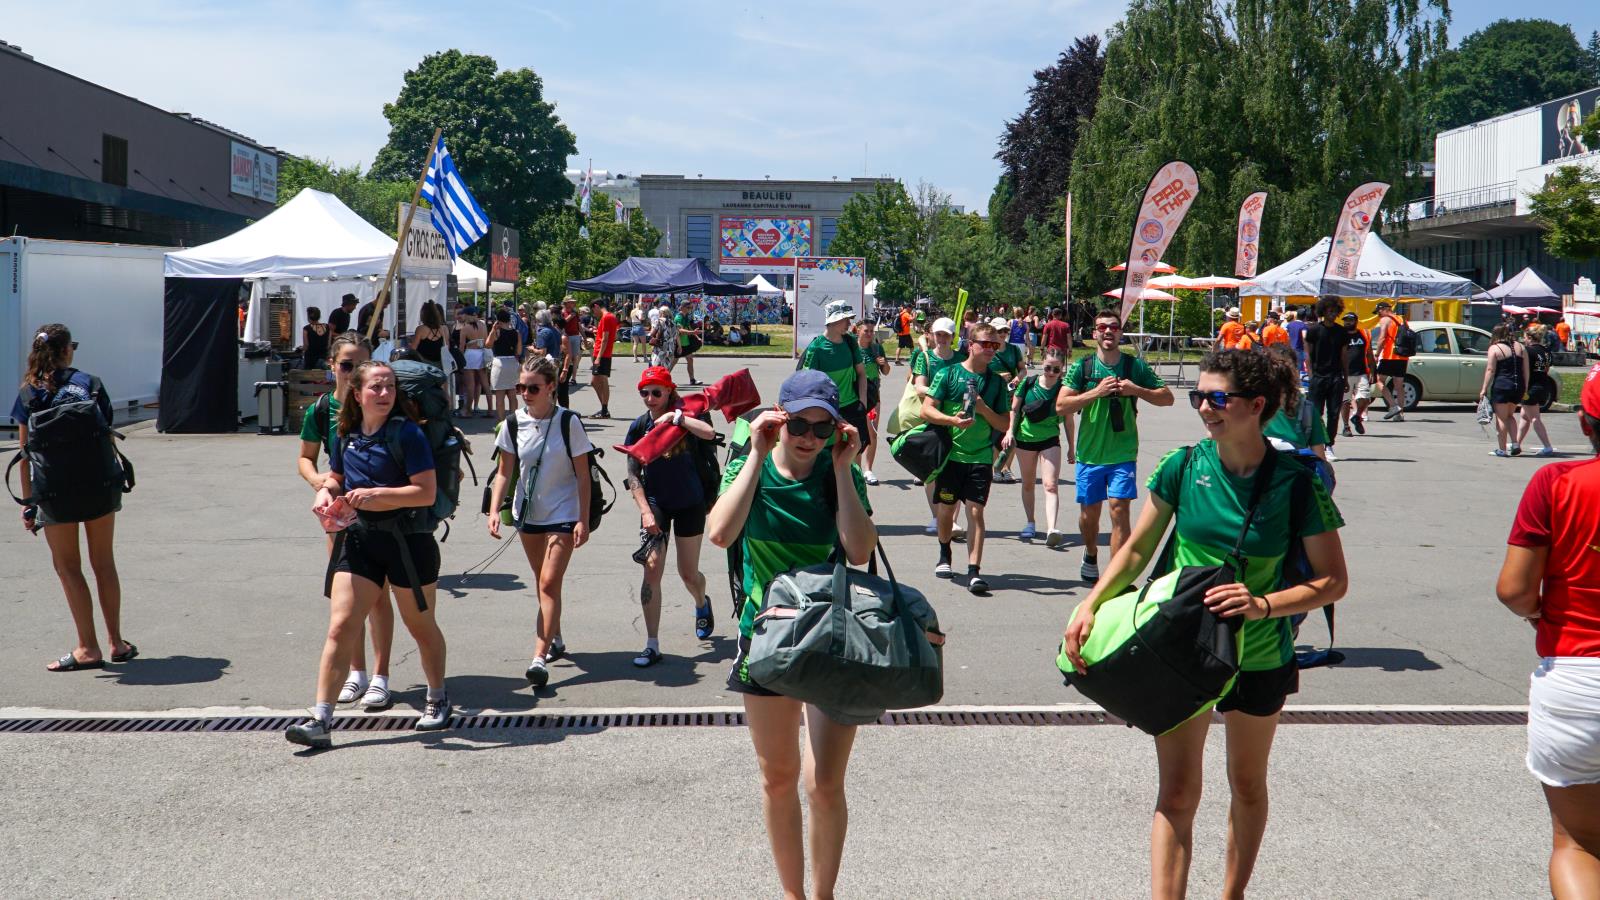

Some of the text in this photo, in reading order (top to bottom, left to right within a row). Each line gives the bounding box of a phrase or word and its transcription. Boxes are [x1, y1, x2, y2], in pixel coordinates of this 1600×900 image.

[742, 192, 792, 200] BEAULIEU
[1152, 178, 1184, 207] PAD
[1158, 189, 1192, 215] THAI
[1346, 187, 1384, 210] CURRY
[407, 227, 429, 258] GYROS
[1362, 281, 1429, 296] TRAITEUR
